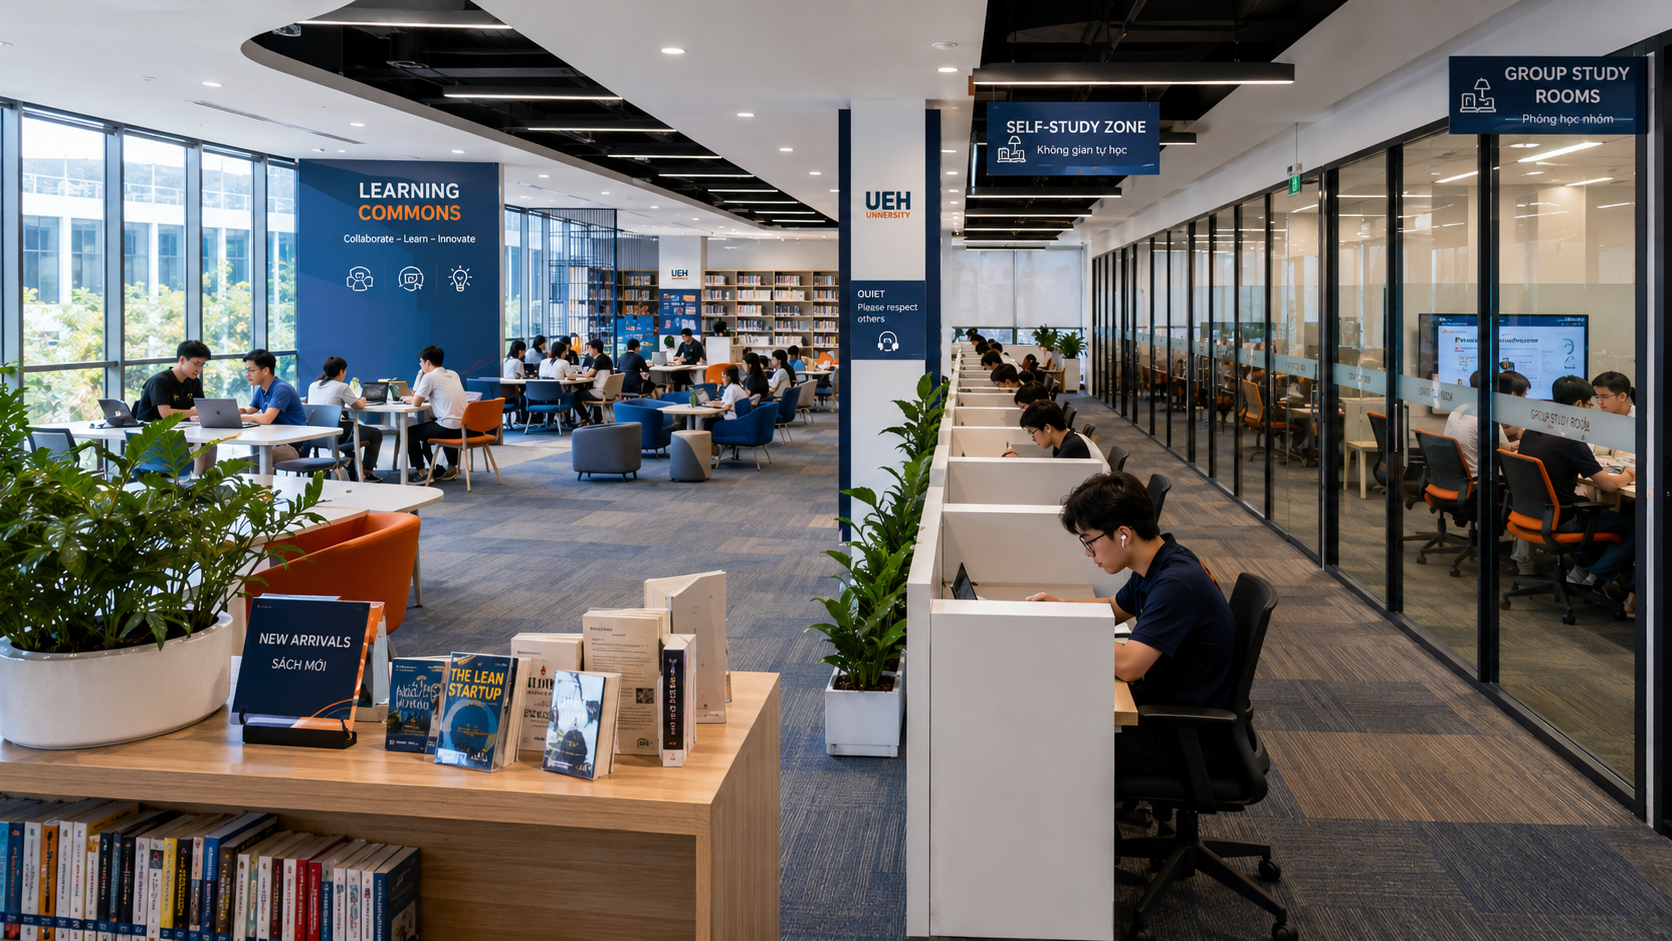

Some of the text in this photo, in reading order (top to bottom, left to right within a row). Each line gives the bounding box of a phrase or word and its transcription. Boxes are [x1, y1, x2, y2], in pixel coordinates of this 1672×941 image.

[1504, 66, 1630, 81] GROUP STUDY
[1535, 89, 1601, 104] ROOMS
[1006, 120, 1146, 134] SELF-STUDY ZONE
[1560, 113, 1580, 127] học
[1582, 113, 1614, 124] nhóm
[1072, 145, 1093, 157] gian
[1108, 145, 1127, 157] học
[359, 182, 460, 199] LEARNING
[866, 191, 911, 210] UEH
[358, 204, 461, 221] COMMONS
[343, 234, 394, 243] Collaborate
[403, 234, 428, 243] Learn
[437, 234, 476, 243] Innovate
[671, 269, 688, 277] UEH
[857, 303, 918, 313] Please respect
[857, 315, 886, 323] others
[259, 632, 352, 648] NEW ARRIVALS
[450, 668, 472, 683] THE
[474, 670, 505, 686] LEAN
[448, 682, 502, 701] STARTUP
